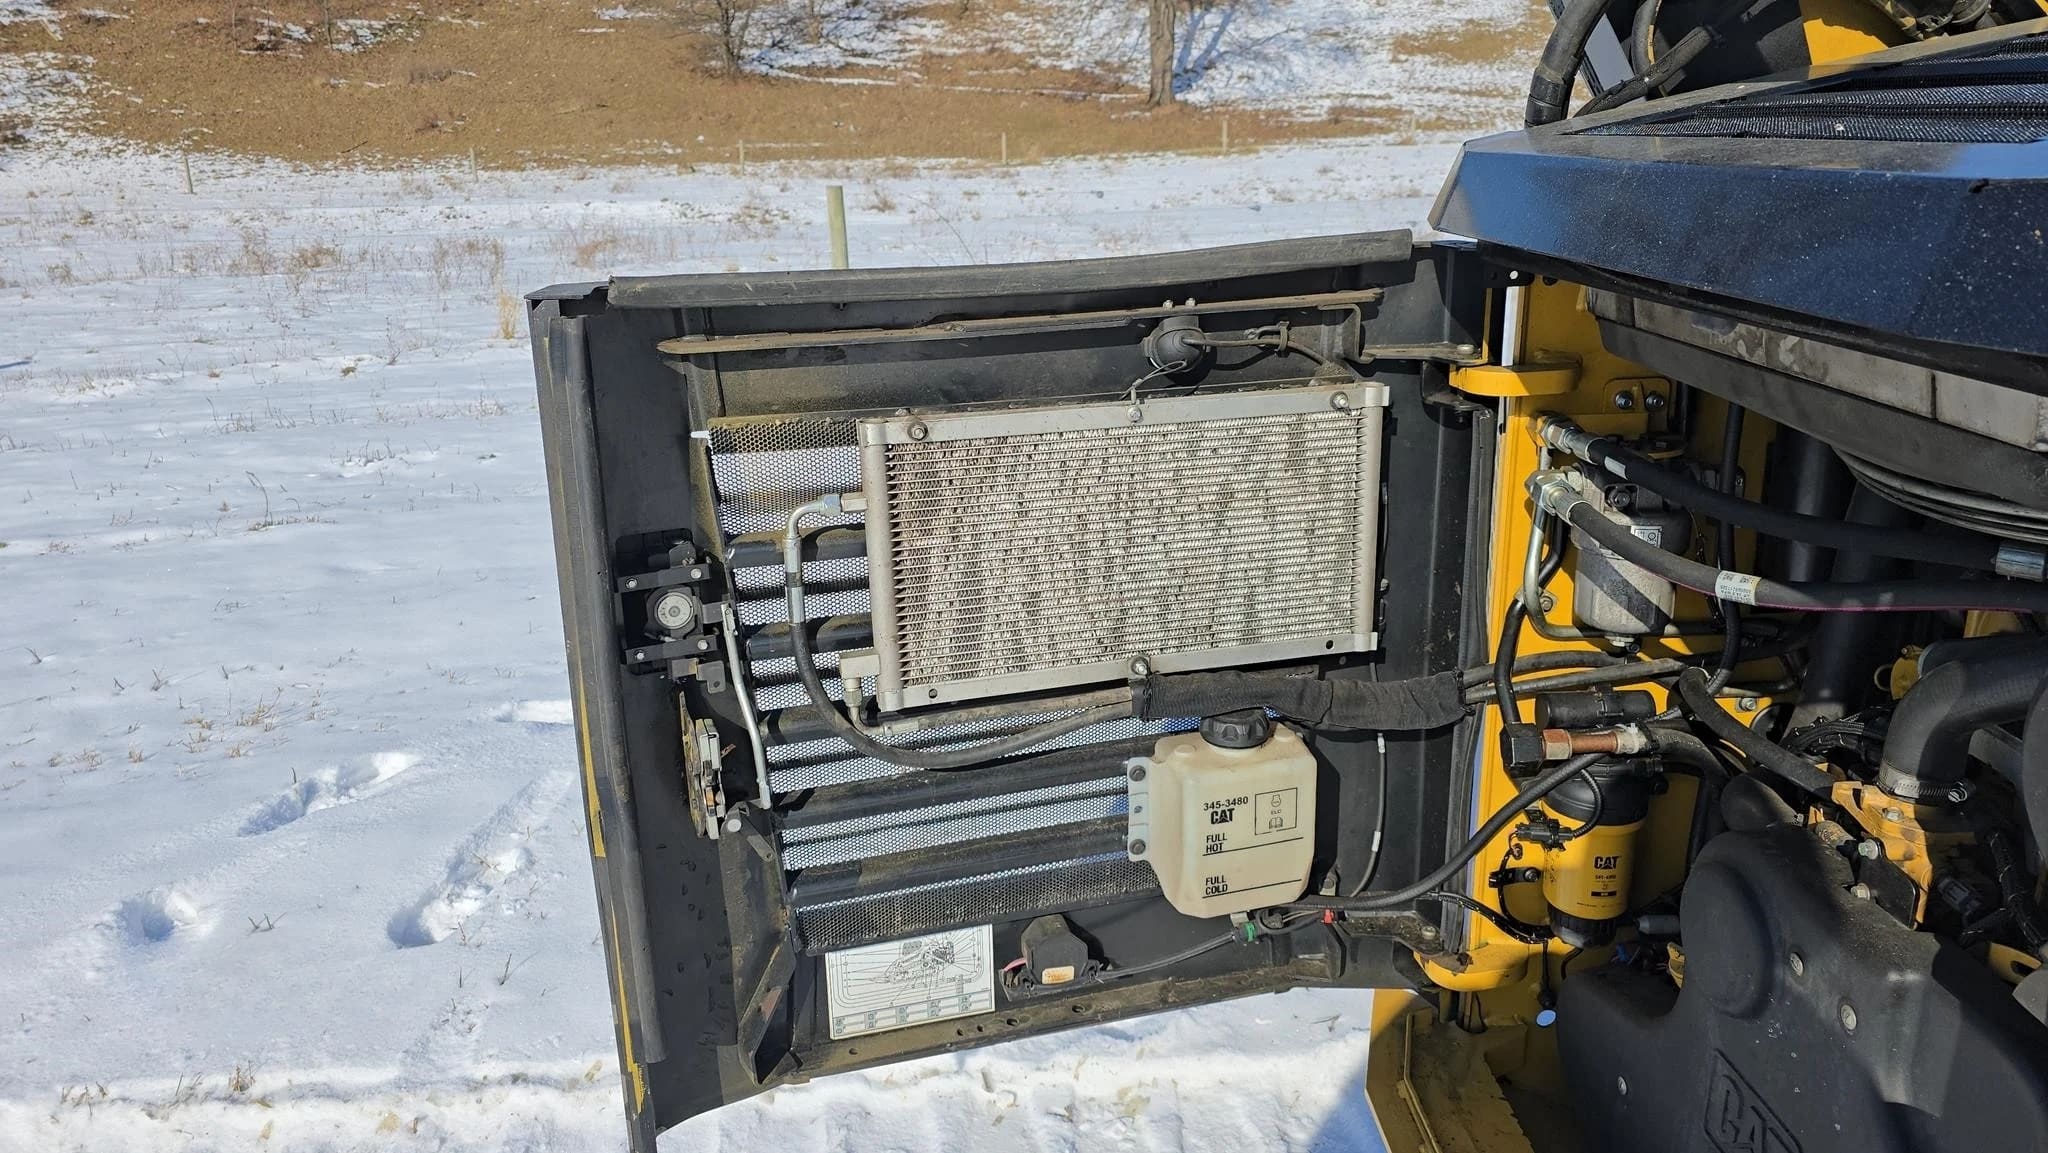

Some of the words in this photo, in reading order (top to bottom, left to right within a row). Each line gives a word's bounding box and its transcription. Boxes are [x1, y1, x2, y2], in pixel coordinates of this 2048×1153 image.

[1203, 796, 1249, 811] 345-3480
[1211, 808, 1235, 824] CAT
[1206, 833, 1228, 843] FULL
[1206, 842, 1224, 853] HOT
[1594, 856, 1620, 869] CAT
[1206, 875, 1227, 886] FULL
[1205, 885, 1228, 895] COLD
